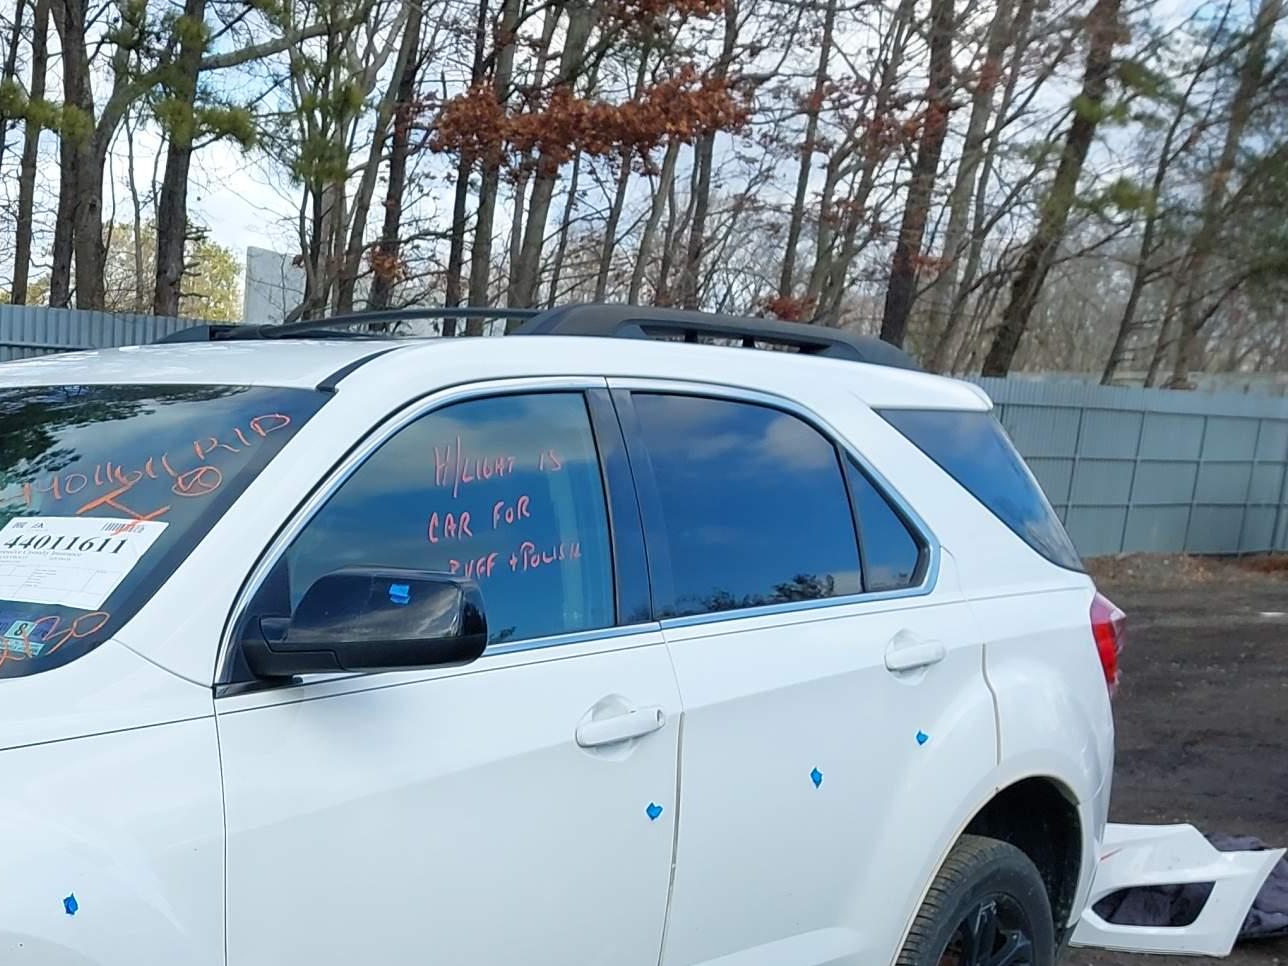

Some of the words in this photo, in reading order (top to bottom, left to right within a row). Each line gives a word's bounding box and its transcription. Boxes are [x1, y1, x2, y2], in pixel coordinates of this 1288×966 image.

[539, 449, 562, 471] IS
[428, 512, 473, 543] CAR
[492, 496, 530, 529] FOR
[3, 534, 129, 554] 44011611
[14, 622, 29, 637] 8
